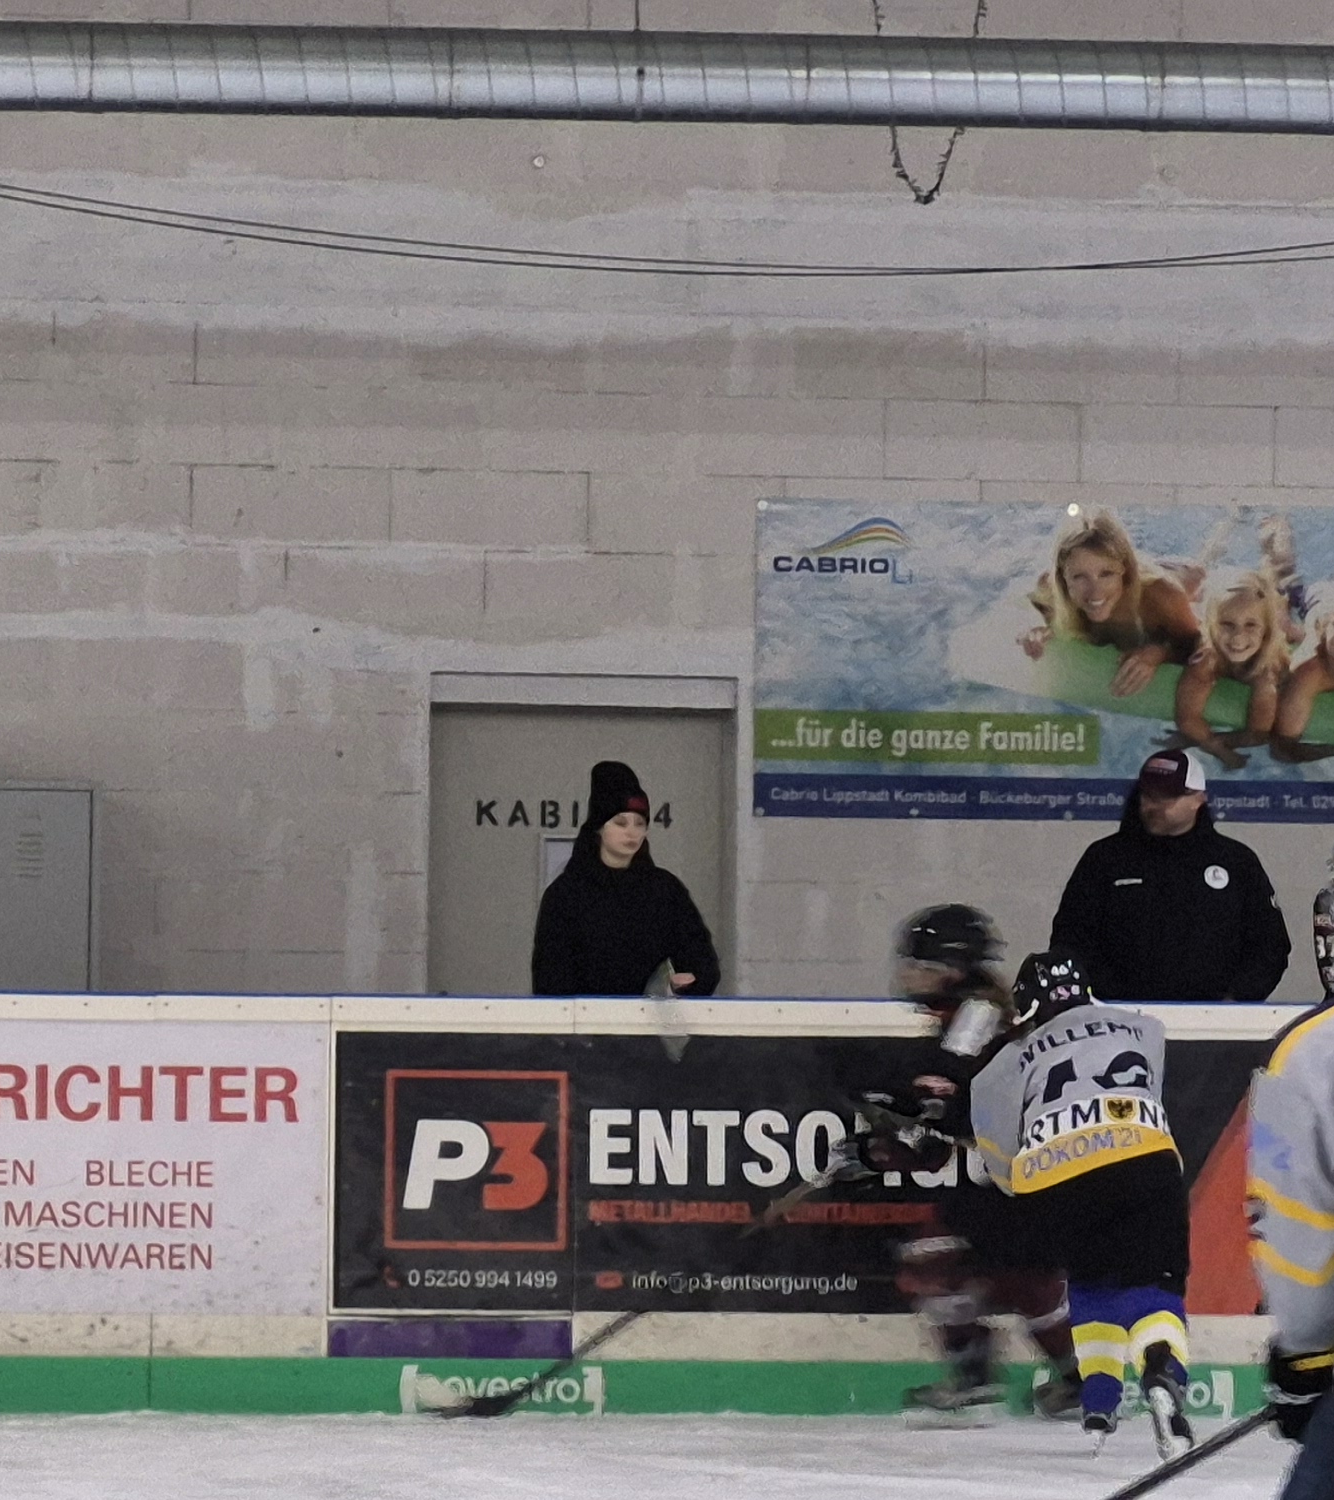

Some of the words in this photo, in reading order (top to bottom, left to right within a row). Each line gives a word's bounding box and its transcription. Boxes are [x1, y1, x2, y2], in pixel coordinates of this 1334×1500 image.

[841, 719, 883, 748] die
[891, 727, 969, 757] ganze
[979, 721, 1086, 752] Familie!
[475, 799, 581, 828] KABI
[653, 802, 673, 829] 4
[1208, 794, 1270, 810] ippstadt
[589, 1108, 993, 1188] ENTSO
[84, 1159, 214, 1188] BLECHE
[402, 1118, 551, 1211] P3
[3, 1200, 214, 1230] MASCHINEN
[408, 1268, 421, 1287] 0
[424, 1268, 471, 1288] 5250
[474, 1269, 511, 1289] 994
[514, 1269, 558, 1289] 1499
